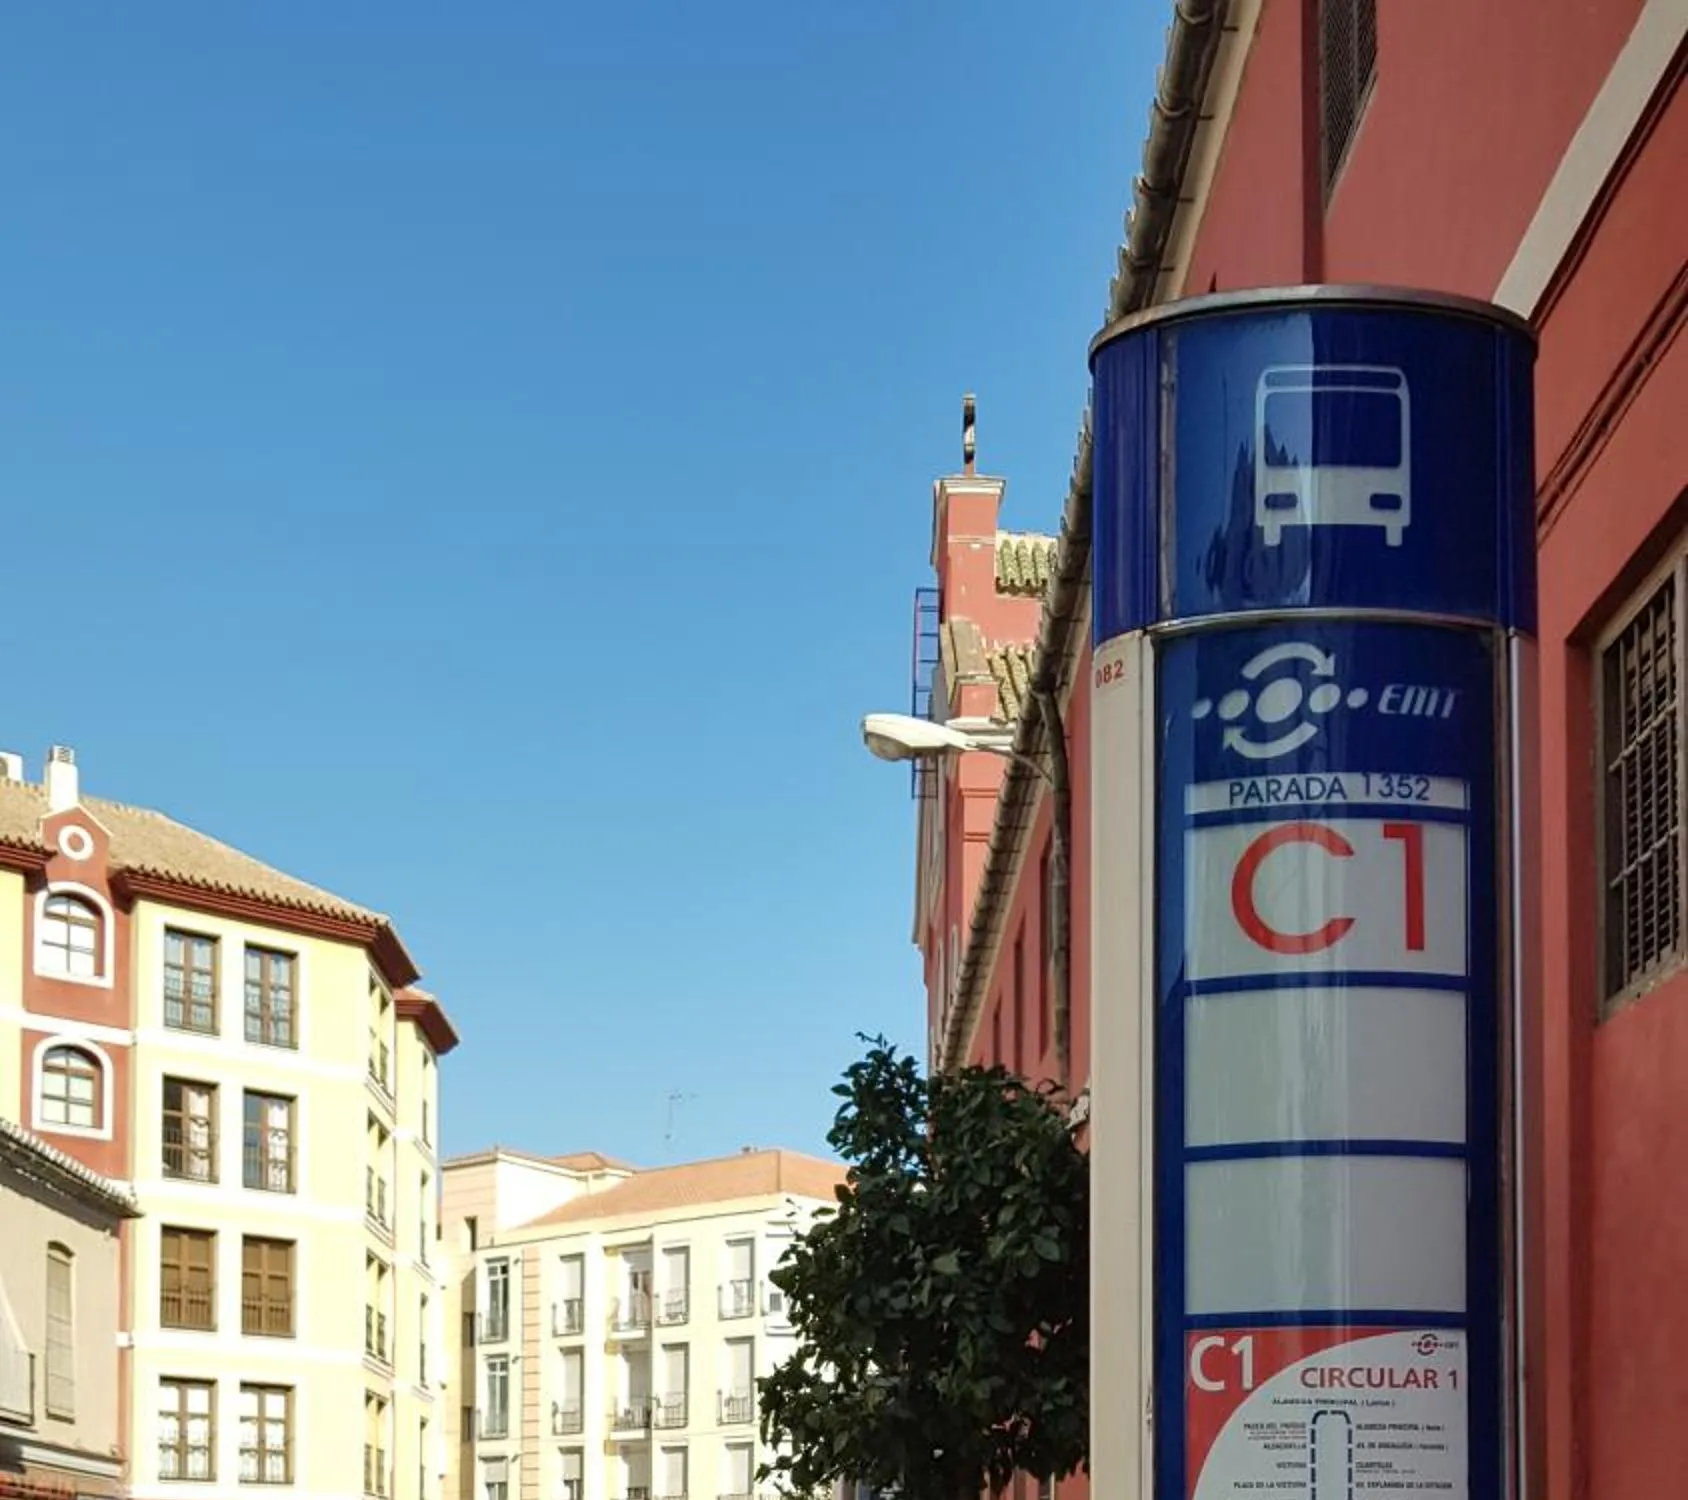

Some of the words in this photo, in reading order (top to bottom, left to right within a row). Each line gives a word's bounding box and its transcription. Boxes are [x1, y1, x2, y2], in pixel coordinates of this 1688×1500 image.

[1229, 776, 1347, 805] PARADA
[1361, 772, 1430, 801] 1352
[1231, 821, 1425, 955] C1
[1190, 1335, 1253, 1392] C1
[1300, 1367, 1438, 1389] CIRCULAR
[1448, 1369, 1458, 1390] 1
